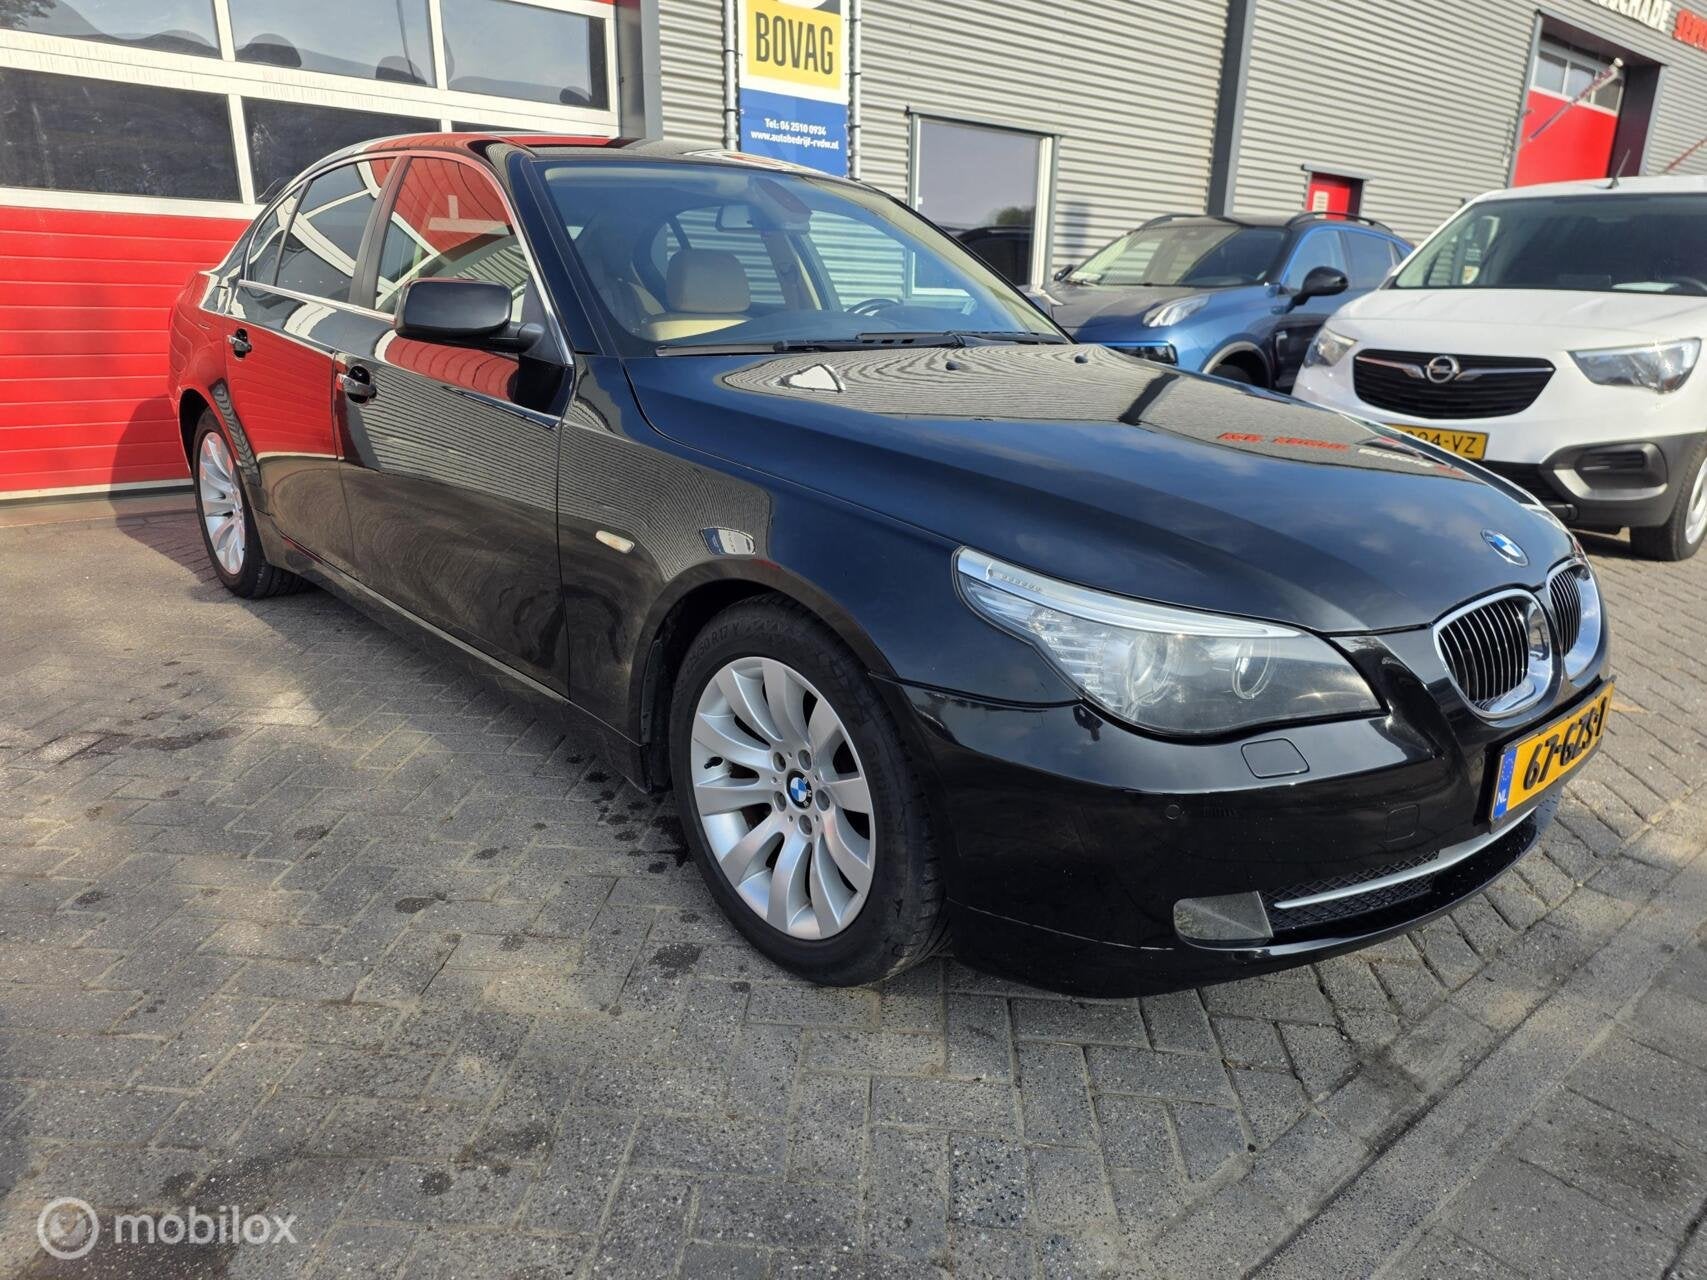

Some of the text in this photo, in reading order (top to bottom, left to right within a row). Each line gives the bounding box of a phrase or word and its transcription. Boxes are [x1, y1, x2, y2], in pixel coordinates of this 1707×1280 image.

[756, 11, 833, 75] BOVAG
[764, 117, 827, 136] Tel: 06 2510 0934
[1405, 430, 1477, 454] 4-VZ
[1522, 696, 1607, 791] 67-GZS-1
[1495, 789, 1507, 806] NL
